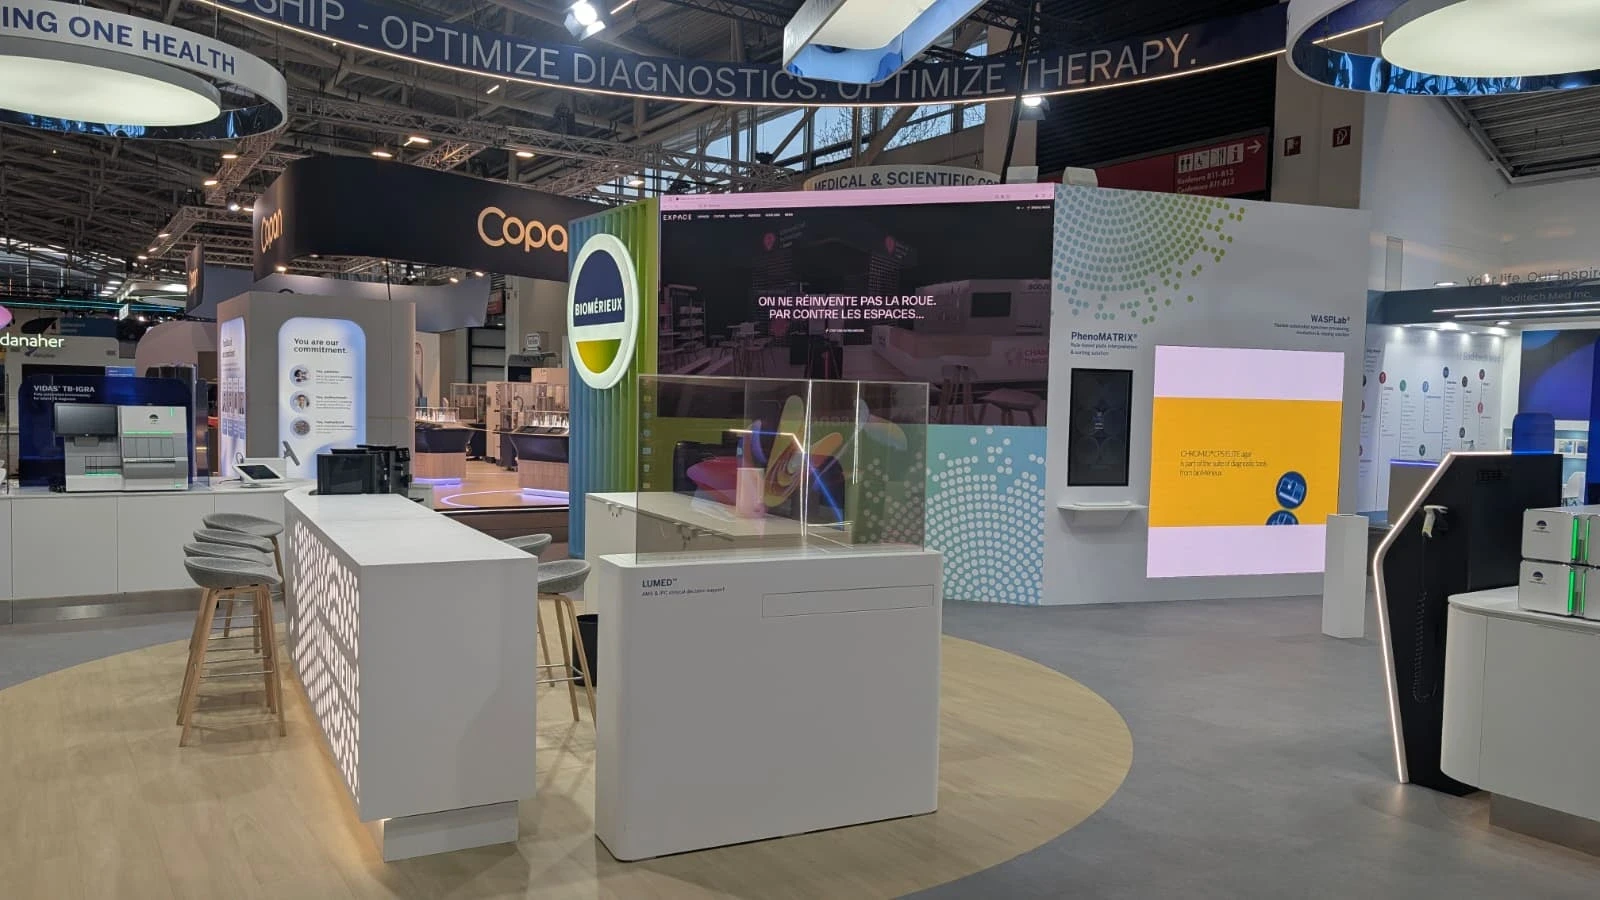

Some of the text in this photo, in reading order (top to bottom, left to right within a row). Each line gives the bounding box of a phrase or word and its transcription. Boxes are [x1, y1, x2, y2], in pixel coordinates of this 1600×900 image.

[2, 6, 235, 75] ING ONE HEALTH
[380, 15, 561, 81] OPTIMIZE
[838, 63, 1006, 99] TIMIZE
[1015, 33, 1196, 90] THERAPY.
[814, 174, 867, 191] MEDICAL
[871, 173, 882, 186] &
[886, 171, 975, 185] SCIENTIFIC
[260, 208, 283, 254] Copan
[1466, 275, 1497, 286] Yor
[1557, 266, 1600, 281] inspir
[574, 296, 623, 317] BIOMÉRIEUX
[758, 294, 937, 307] ON NE RÉINVENTE PAS LA ROUE.
[769, 308, 790, 320] PAR
[792, 308, 839, 320] CONTRE
[841, 308, 861, 320] LES
[0, 332, 65, 348] danaher
